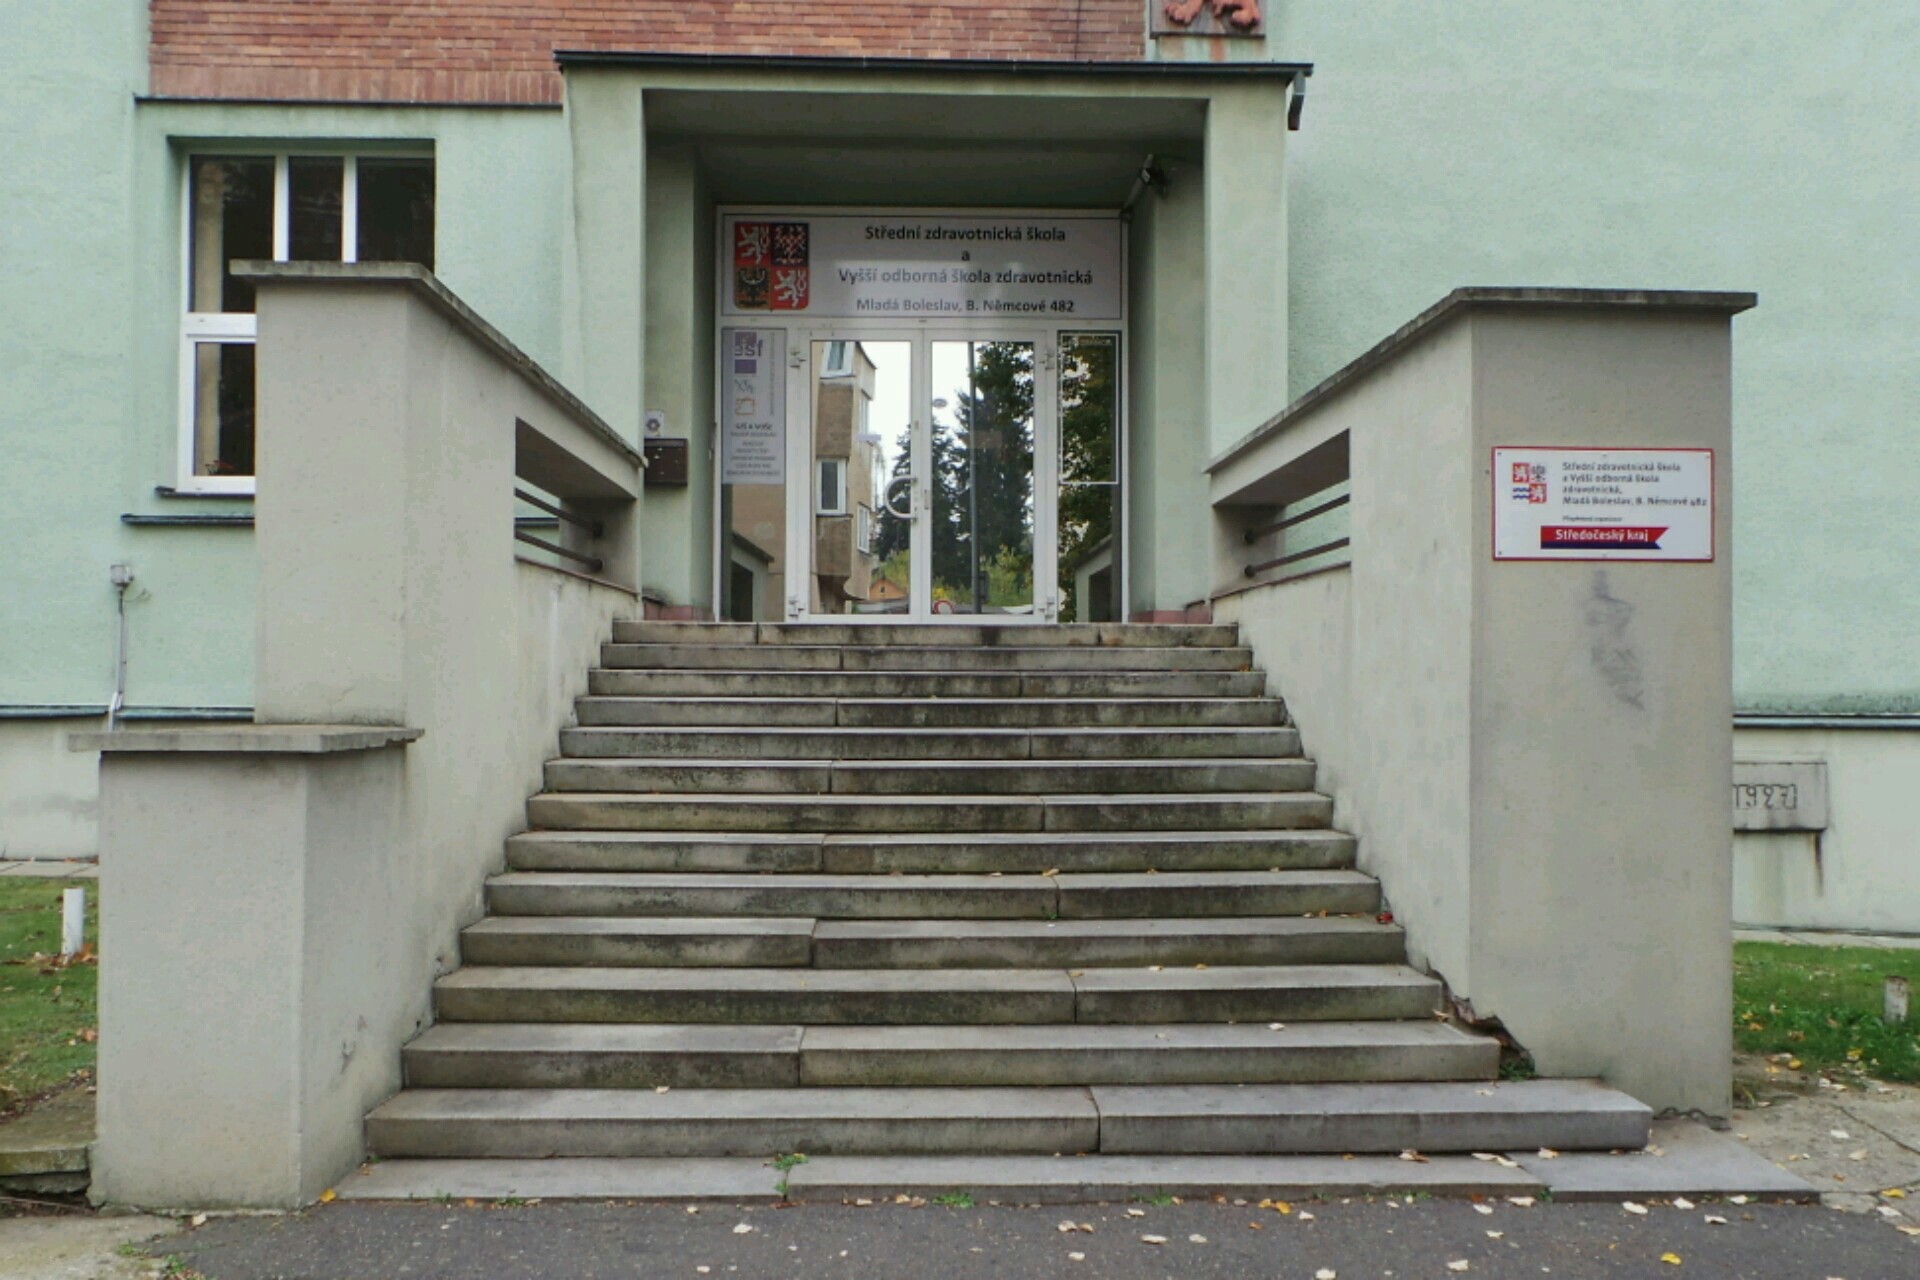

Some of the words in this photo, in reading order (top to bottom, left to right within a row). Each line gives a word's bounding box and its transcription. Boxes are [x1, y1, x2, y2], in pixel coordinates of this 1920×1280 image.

[865, 225, 921, 241] Střední
[926, 226, 1022, 241] zdravotnická
[1026, 226, 1066, 241] škola
[961, 250, 971, 261] a
[838, 267, 877, 285] Vyšší
[882, 267, 947, 283] odborná
[951, 268, 991, 284] škola
[996, 269, 1093, 285] zdravotnická
[856, 297, 899, 311] Mladá
[903, 298, 962, 313] Boleslav,
[966, 299, 978, 312] B.
[983, 299, 1046, 313] Němcové
[1050, 299, 1075, 313] 482
[1562, 461, 1596, 471] Střední
[1597, 462, 1654, 471] zdravotnická
[1657, 462, 1681, 472] škola
[1570, 473, 1593, 484] Vyšší
[1595, 473, 1632, 483] odborná
[1635, 474, 1660, 483] škola
[1562, 496, 1590, 505] Mladá
[1647, 496, 1688, 506] Němcové
[1555, 529, 1625, 542] Středočeský
[1627, 529, 1649, 542] kraj
